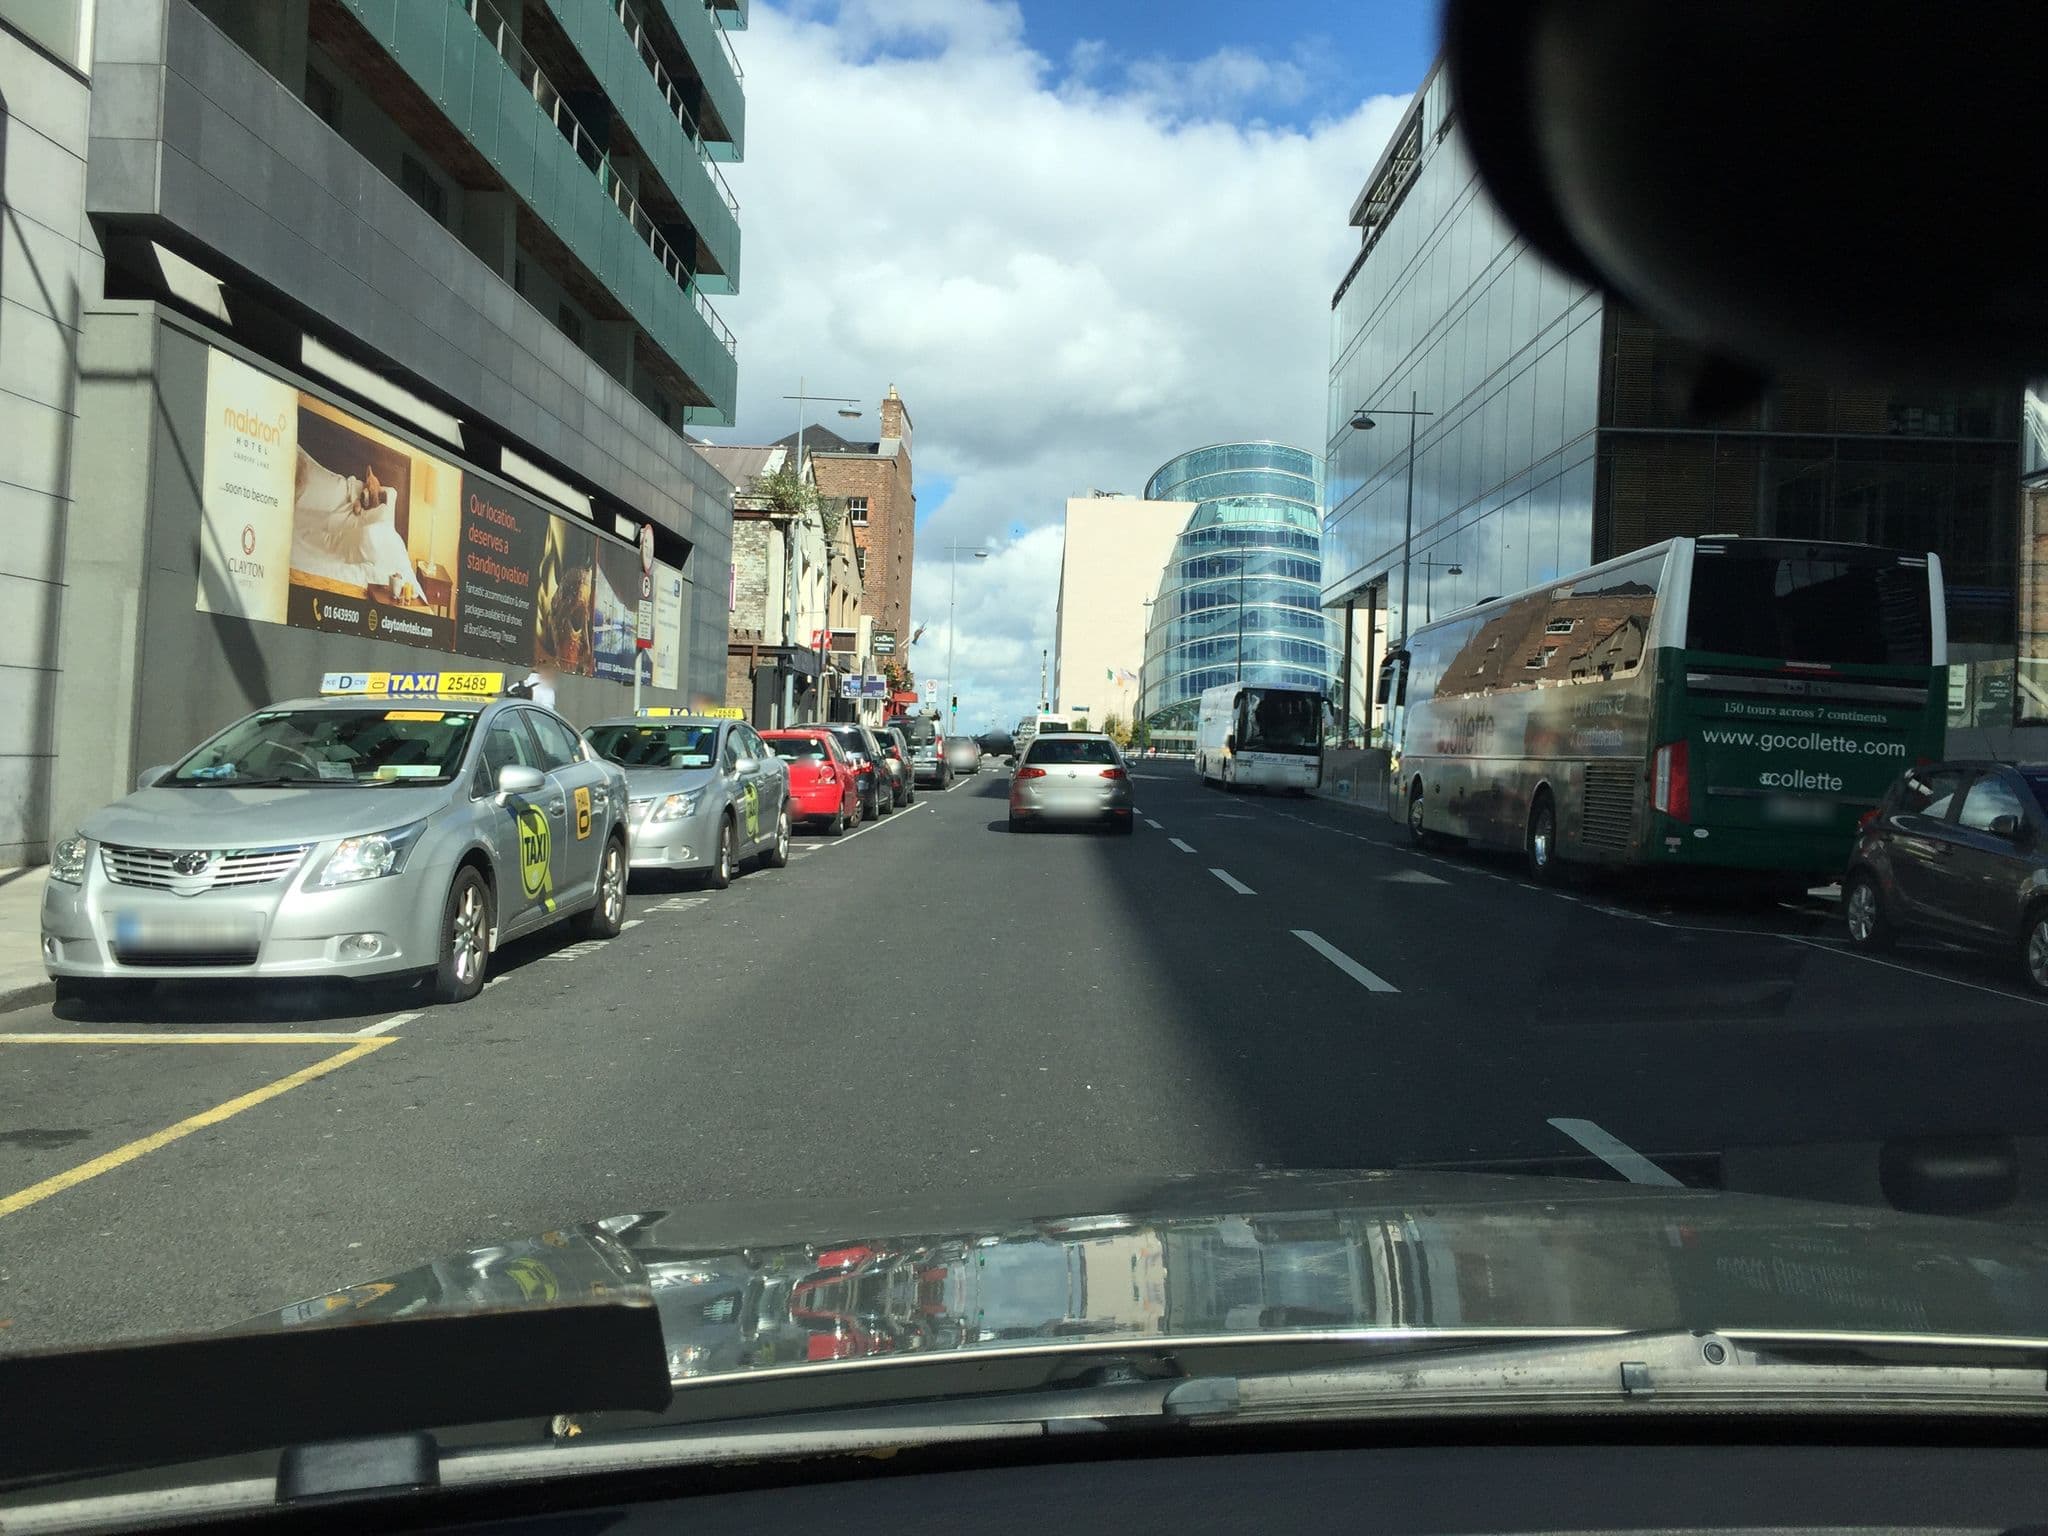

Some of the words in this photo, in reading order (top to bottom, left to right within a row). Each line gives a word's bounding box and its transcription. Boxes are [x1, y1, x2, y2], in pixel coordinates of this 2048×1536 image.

[223, 407, 281, 447] maldron
[236, 437, 268, 456] HOTEL
[251, 488, 279, 508] become
[470, 494, 485, 517] Our
[468, 522, 504, 553] deserves
[503, 540, 509, 555] a
[227, 557, 265, 579] CLAYTON
[467, 552, 501, 583] standing
[381, 615, 433, 638] claytonhotels.com
[339, 676, 353, 689] D
[391, 675, 437, 691] TAXI
[448, 677, 487, 690] 25489
[1724, 702, 1744, 714] 150
[1747, 704, 1776, 716] tours
[1779, 707, 1815, 719] across
[1818, 708, 1825, 719] 7
[1827, 710, 1888, 724] continents
[1702, 729, 1906, 757] www.gocollette.com
[524, 832, 547, 867] TAXI
